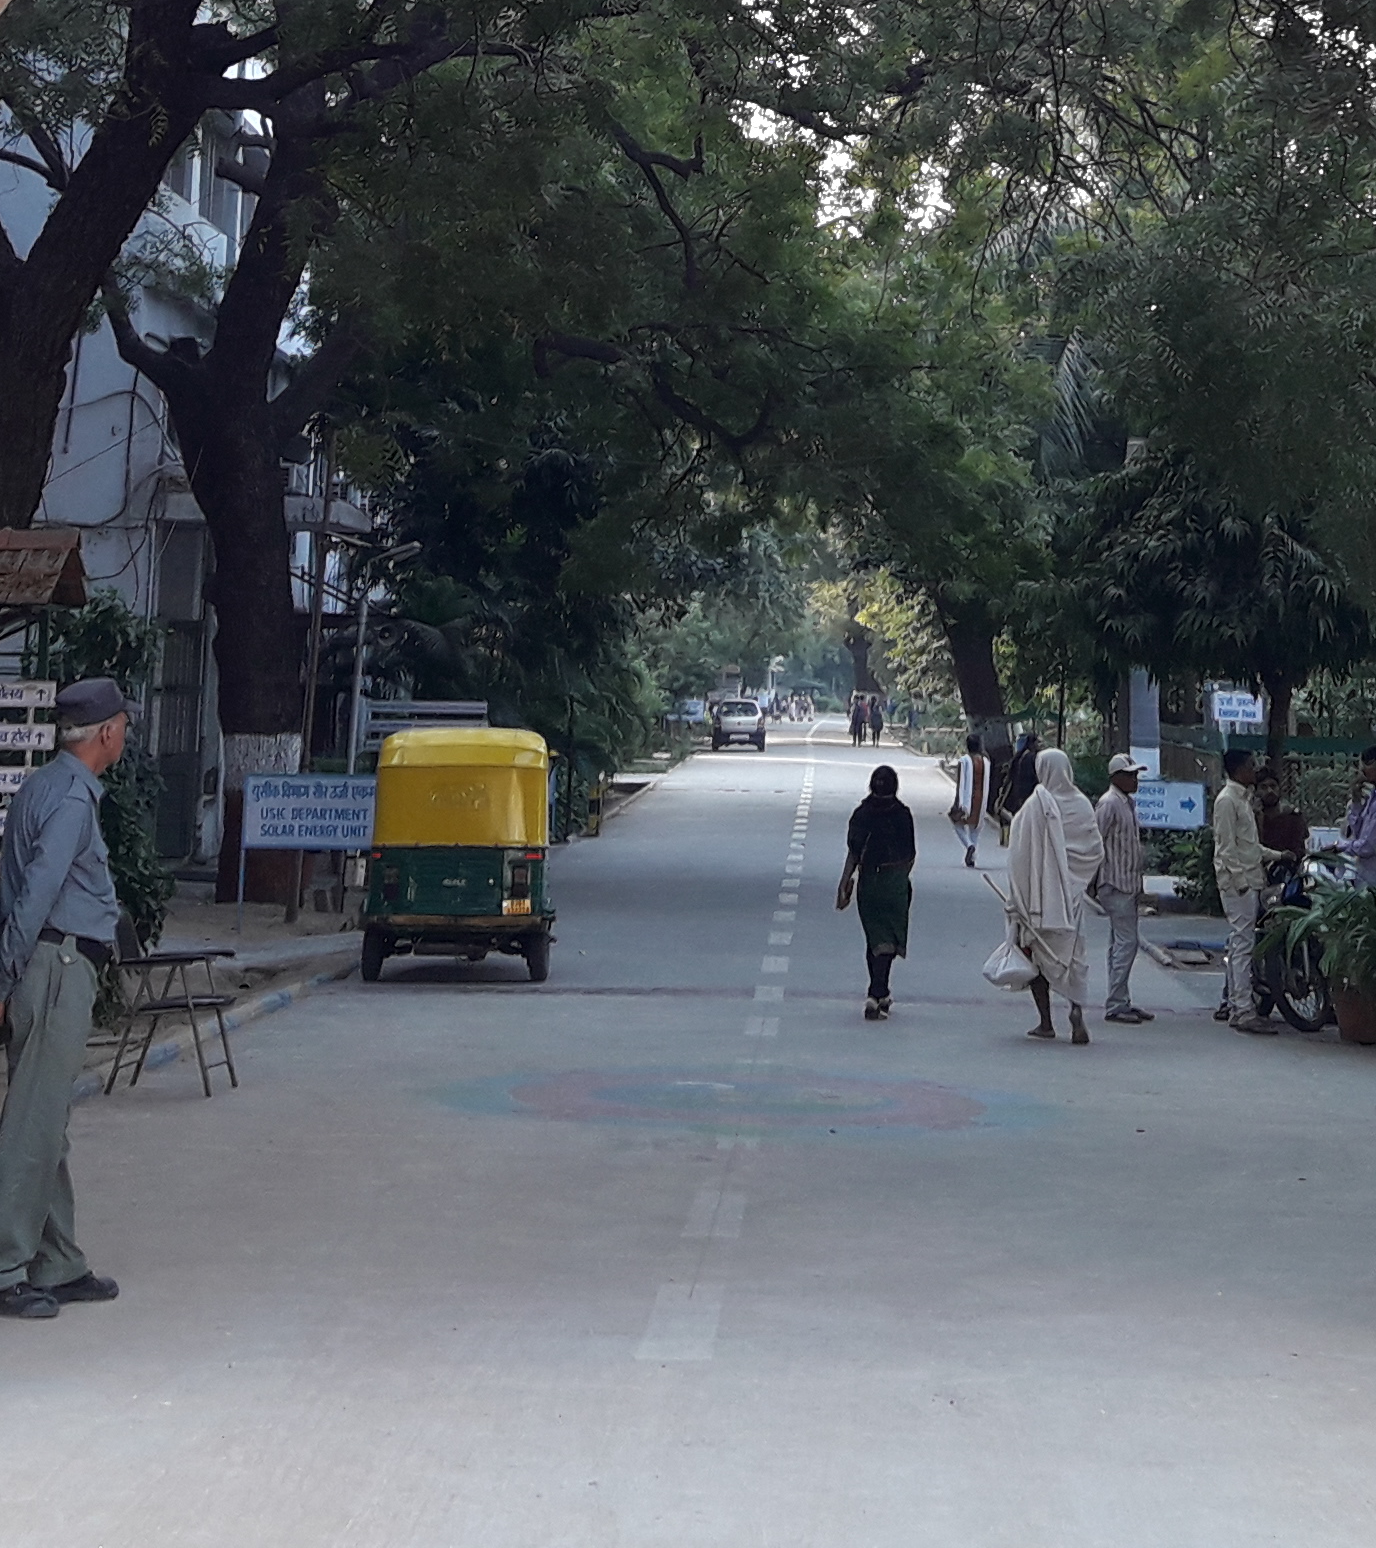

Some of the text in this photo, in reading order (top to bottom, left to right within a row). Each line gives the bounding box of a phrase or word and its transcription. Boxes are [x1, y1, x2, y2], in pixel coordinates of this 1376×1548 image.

[260, 806, 369, 822] USIC DEPARTMENT
[260, 823, 369, 840] SOLAR ENERGY UNIT
